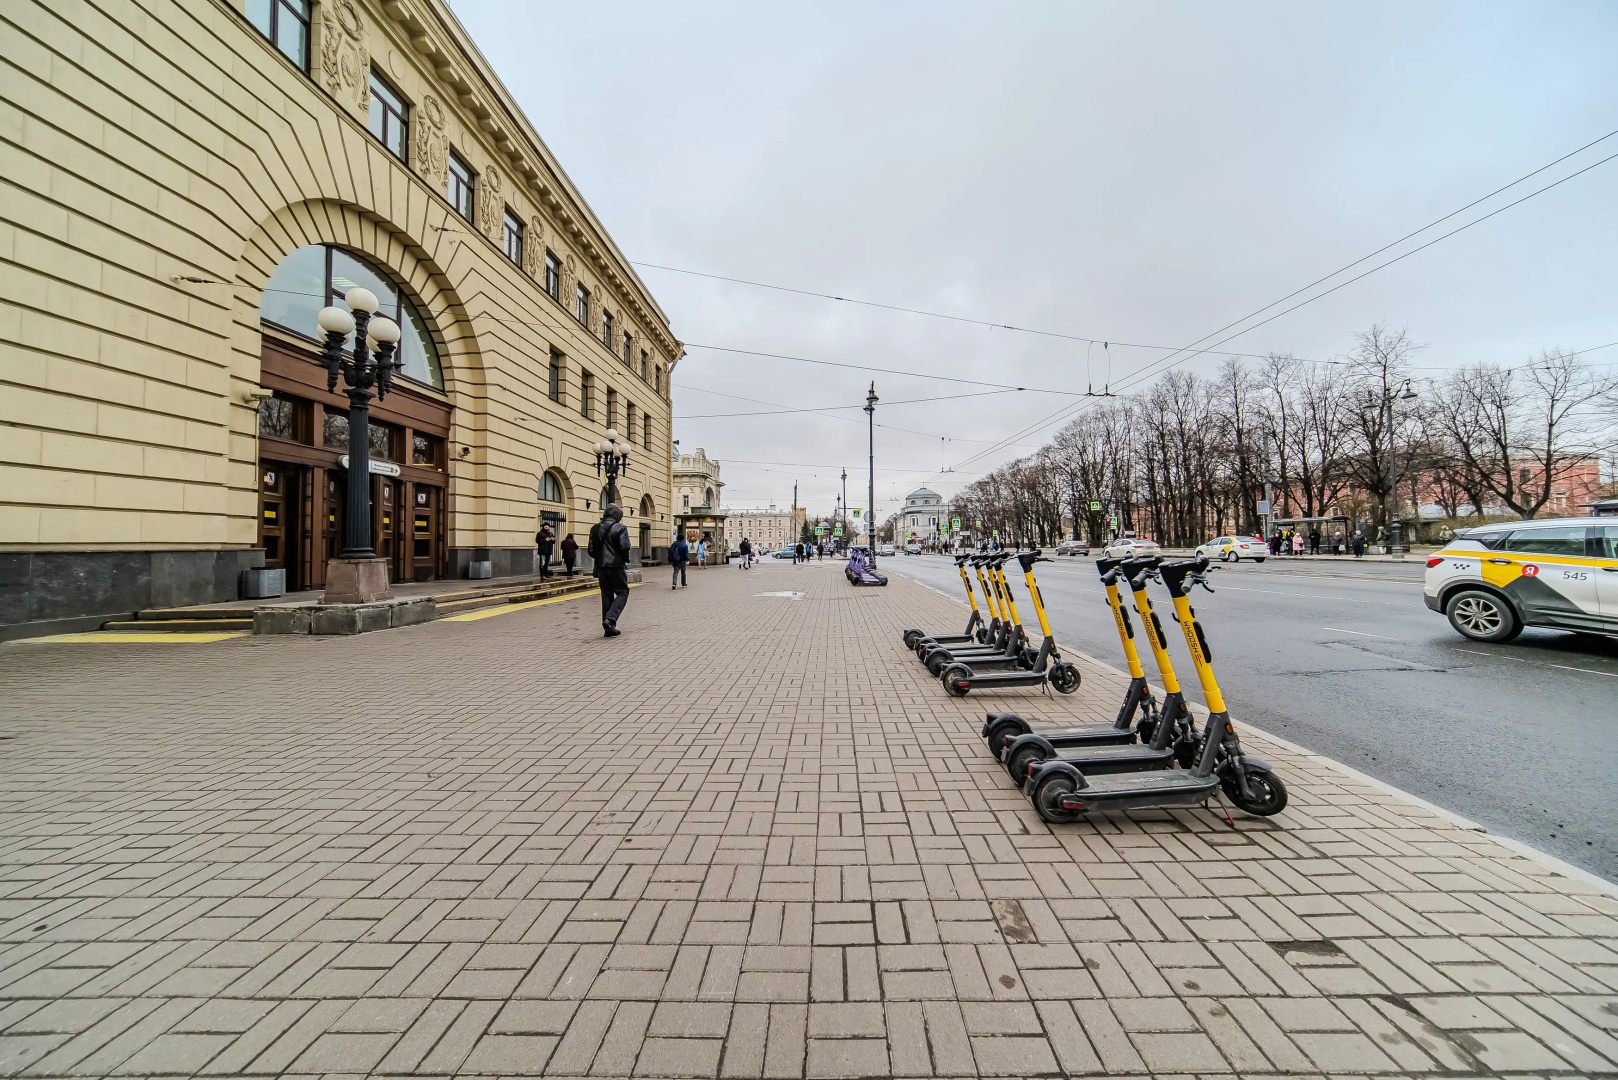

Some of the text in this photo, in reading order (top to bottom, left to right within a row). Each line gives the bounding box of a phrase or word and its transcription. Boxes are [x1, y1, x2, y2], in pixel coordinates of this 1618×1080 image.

[1526, 566, 1535, 575] Я
[1562, 571, 1588, 581] 545
[1113, 605, 1125, 631] WHOOSH
[1142, 611, 1156, 641] WHOOSH
[1184, 621, 1200, 654] WHOOSH
